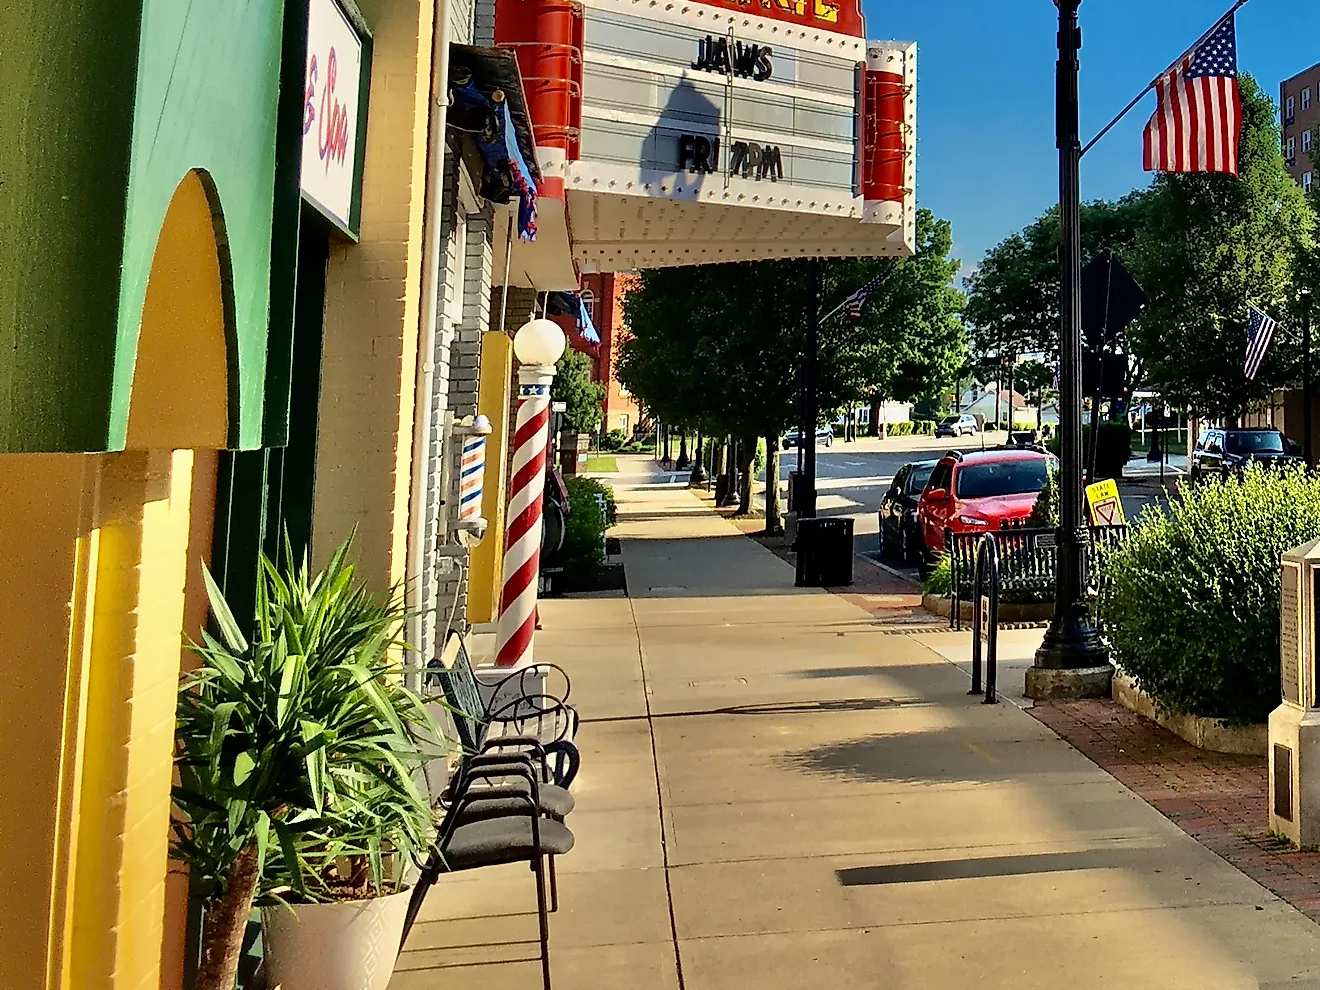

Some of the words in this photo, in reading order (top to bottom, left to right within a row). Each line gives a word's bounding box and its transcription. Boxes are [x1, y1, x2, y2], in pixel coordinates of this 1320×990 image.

[691, 35, 773, 82] JAWS
[319, 46, 348, 176] Spa
[679, 133, 720, 175] FRI
[730, 141, 783, 182] 7PM
[1092, 483, 1110, 493] STATE
[1096, 491, 1109, 499] LAW
